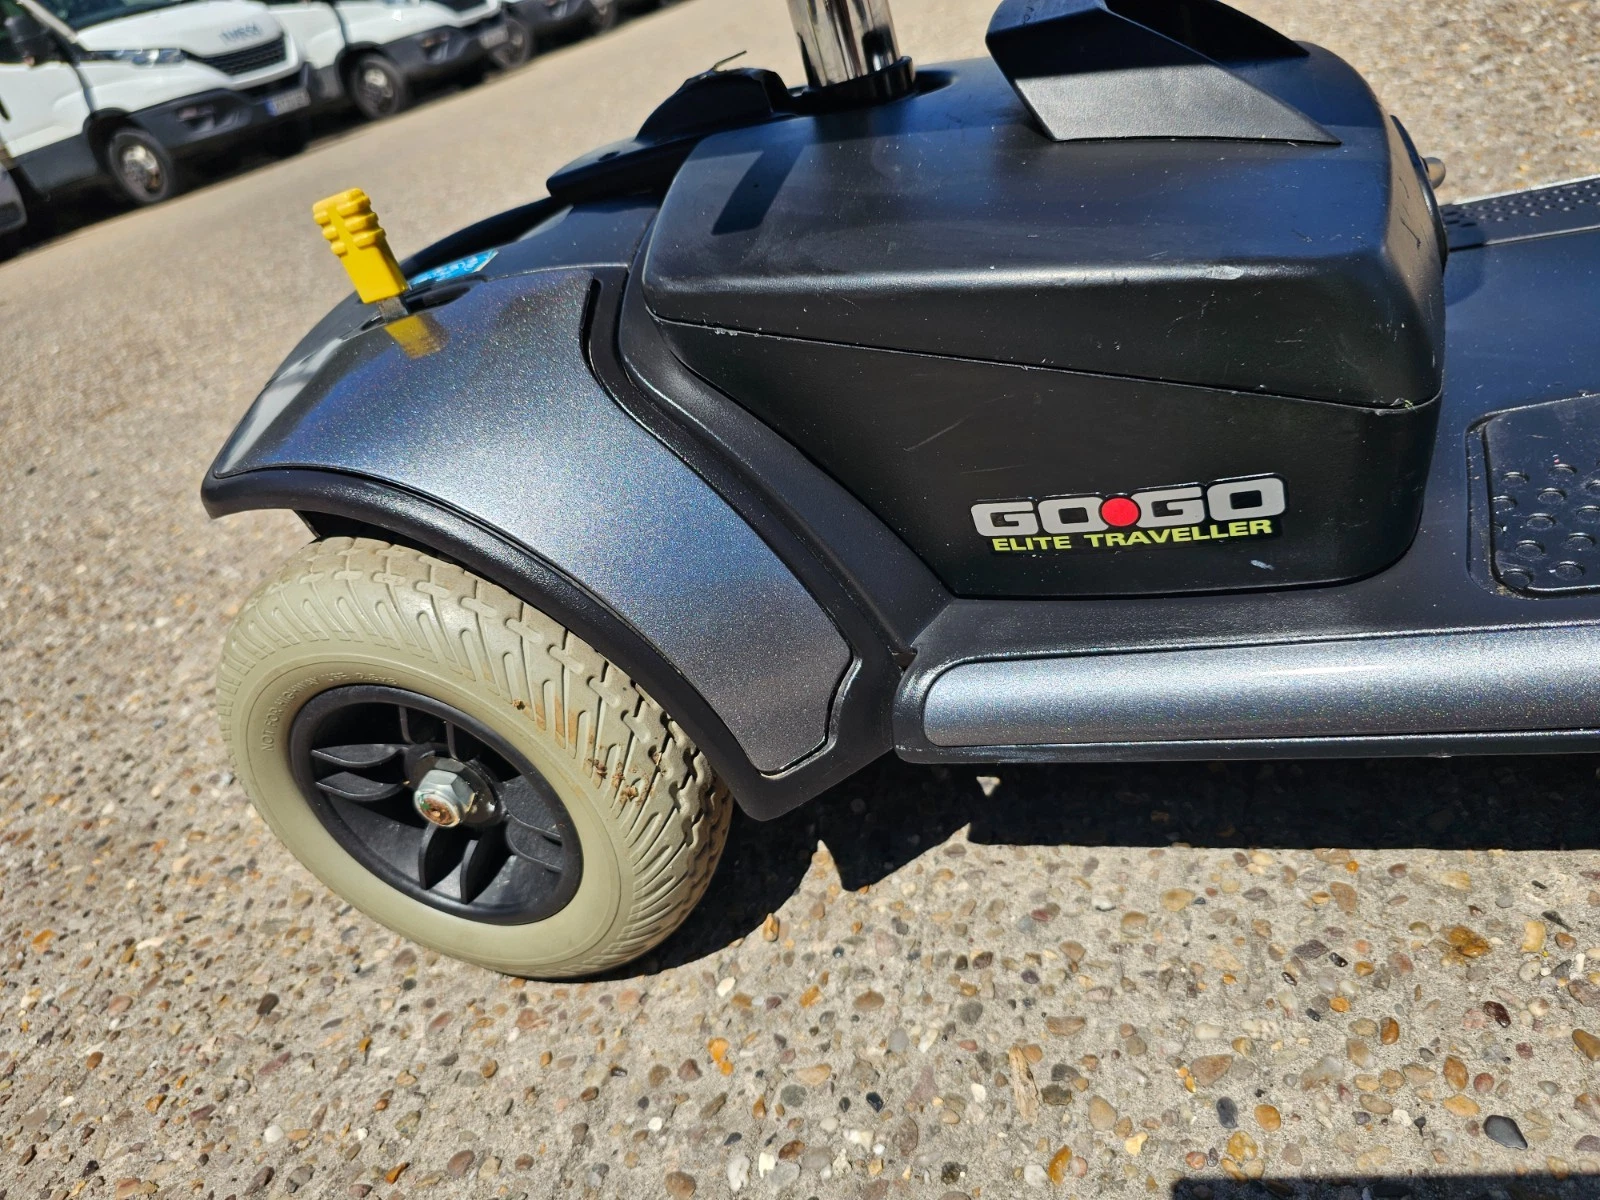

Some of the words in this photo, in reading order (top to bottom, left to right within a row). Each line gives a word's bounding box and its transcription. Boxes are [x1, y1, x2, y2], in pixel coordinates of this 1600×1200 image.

[991, 536, 1072, 552] ELITE
[1084, 519, 1273, 548] TRAVELLER
[266, 706, 284, 727] FOR
[261, 729, 275, 752] NOT
